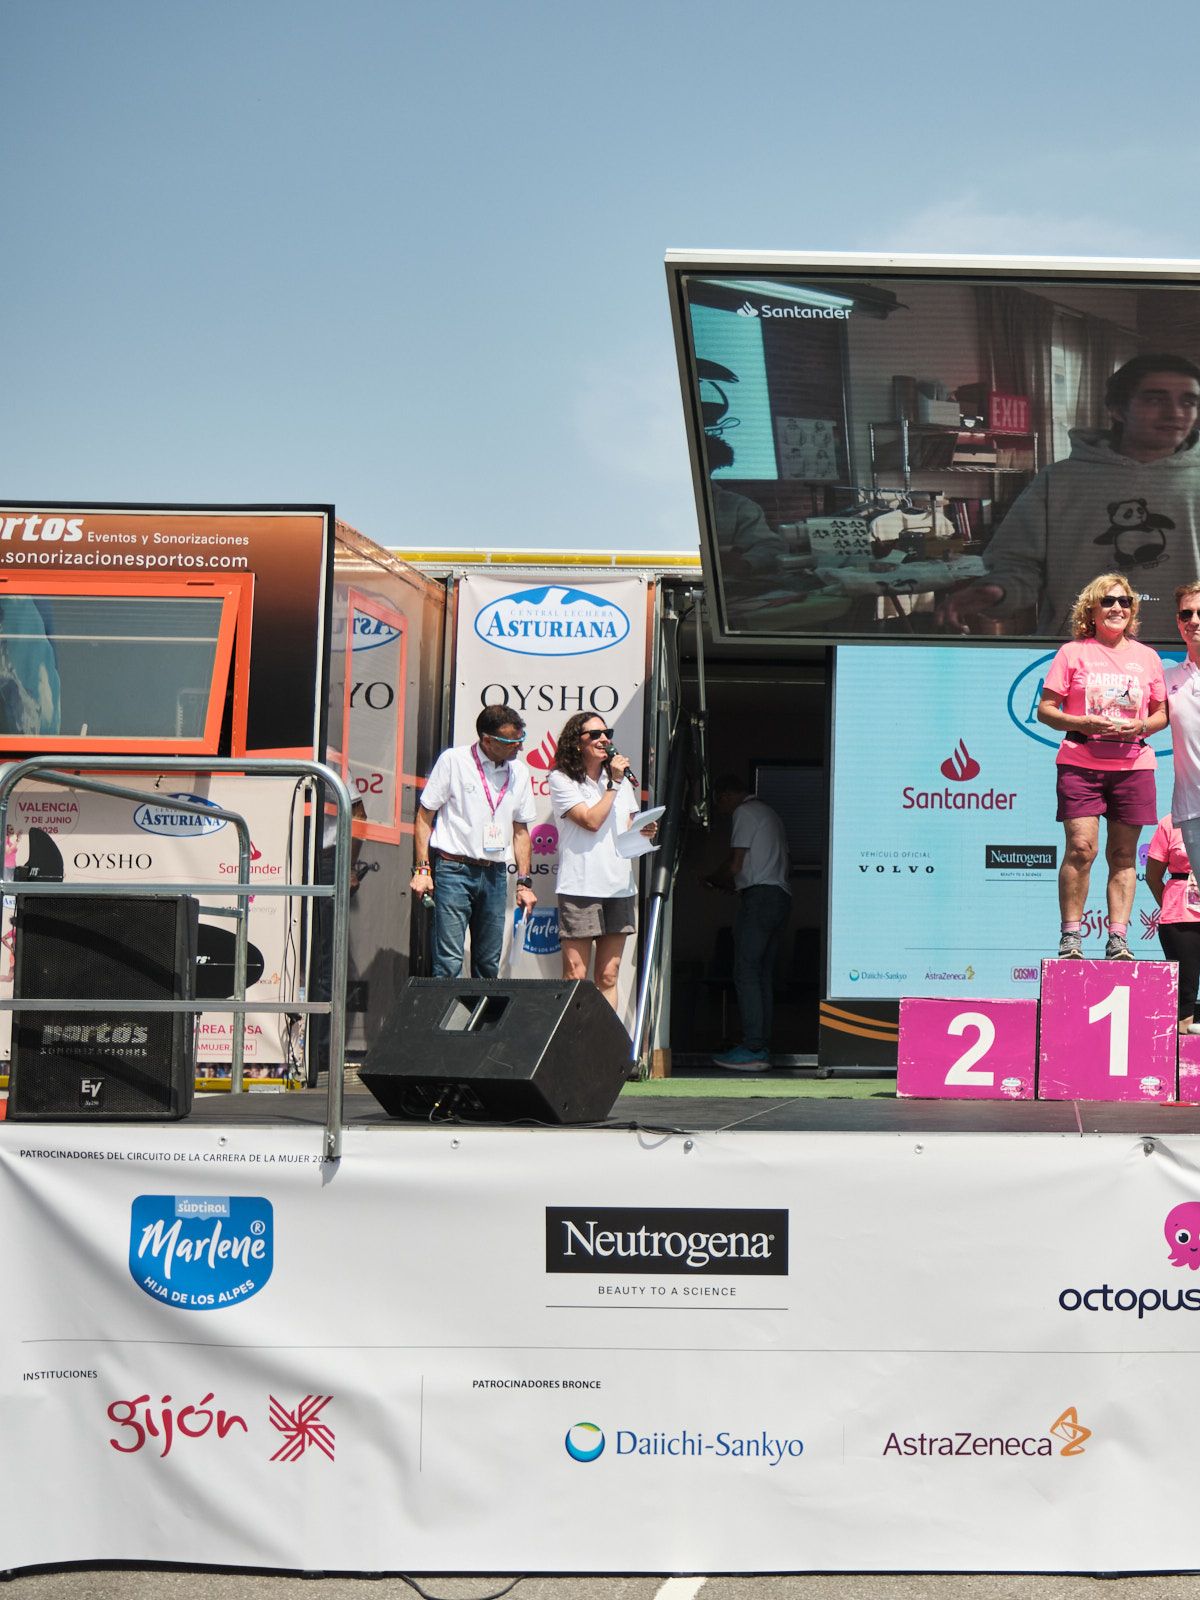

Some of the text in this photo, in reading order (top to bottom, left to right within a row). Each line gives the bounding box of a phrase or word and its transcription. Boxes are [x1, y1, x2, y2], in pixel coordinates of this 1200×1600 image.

[761, 305, 852, 319] Santander
[992, 397, 1027, 428] EXIT
[0, 514, 249, 546] rtos Eventos y Sonorizaciones
[511, 609, 614, 618] CENTRAL LECHERA
[486, 611, 618, 638] ASTURIANA
[480, 684, 619, 713] OYSHO
[902, 786, 1017, 810] Santander
[18, 802, 78, 813] VALENCIA
[141, 808, 221, 826] ASTURIANA
[74, 852, 152, 871] OYSHO
[861, 850, 931, 859] VEHÍCULO OFICIAL
[991, 850, 1052, 866] Neutrogena
[219, 863, 282, 875] Sanander
[859, 865, 935, 874] VOLVO
[925, 971, 966, 981] AstraZeneca
[1013, 968, 1038, 980] COSMO
[1088, 985, 1131, 1077] 1
[944, 1012, 996, 1086] 2
[81, 1080, 102, 1098] EV
[20, 1150, 105, 1160] PATROCINADORES
[107, 1151, 125, 1161] DEL
[127, 1152, 171, 1161] CIRCUITO
[173, 1153, 186, 1162] DE
[188, 1153, 201, 1162] LA
[203, 1153, 247, 1162] CARRERA
[249, 1154, 262, 1163] DE
[264, 1154, 276, 1163] LA
[278, 1154, 310, 1163] MUJER
[143, 1276, 255, 1305] HIJA DE LOS ALPES
[598, 1286, 737, 1296] BEAUTY TO A SCIENCE
[23, 1370, 98, 1381] INSTITUCIONES
[472, 1379, 602, 1389] PATROCINADORES BRONCE
[107, 1392, 249, 1458] gijón
[616, 1430, 804, 1466] Daiichi-Sankyo
[882, 1431, 1053, 1457] AstraZeneca
